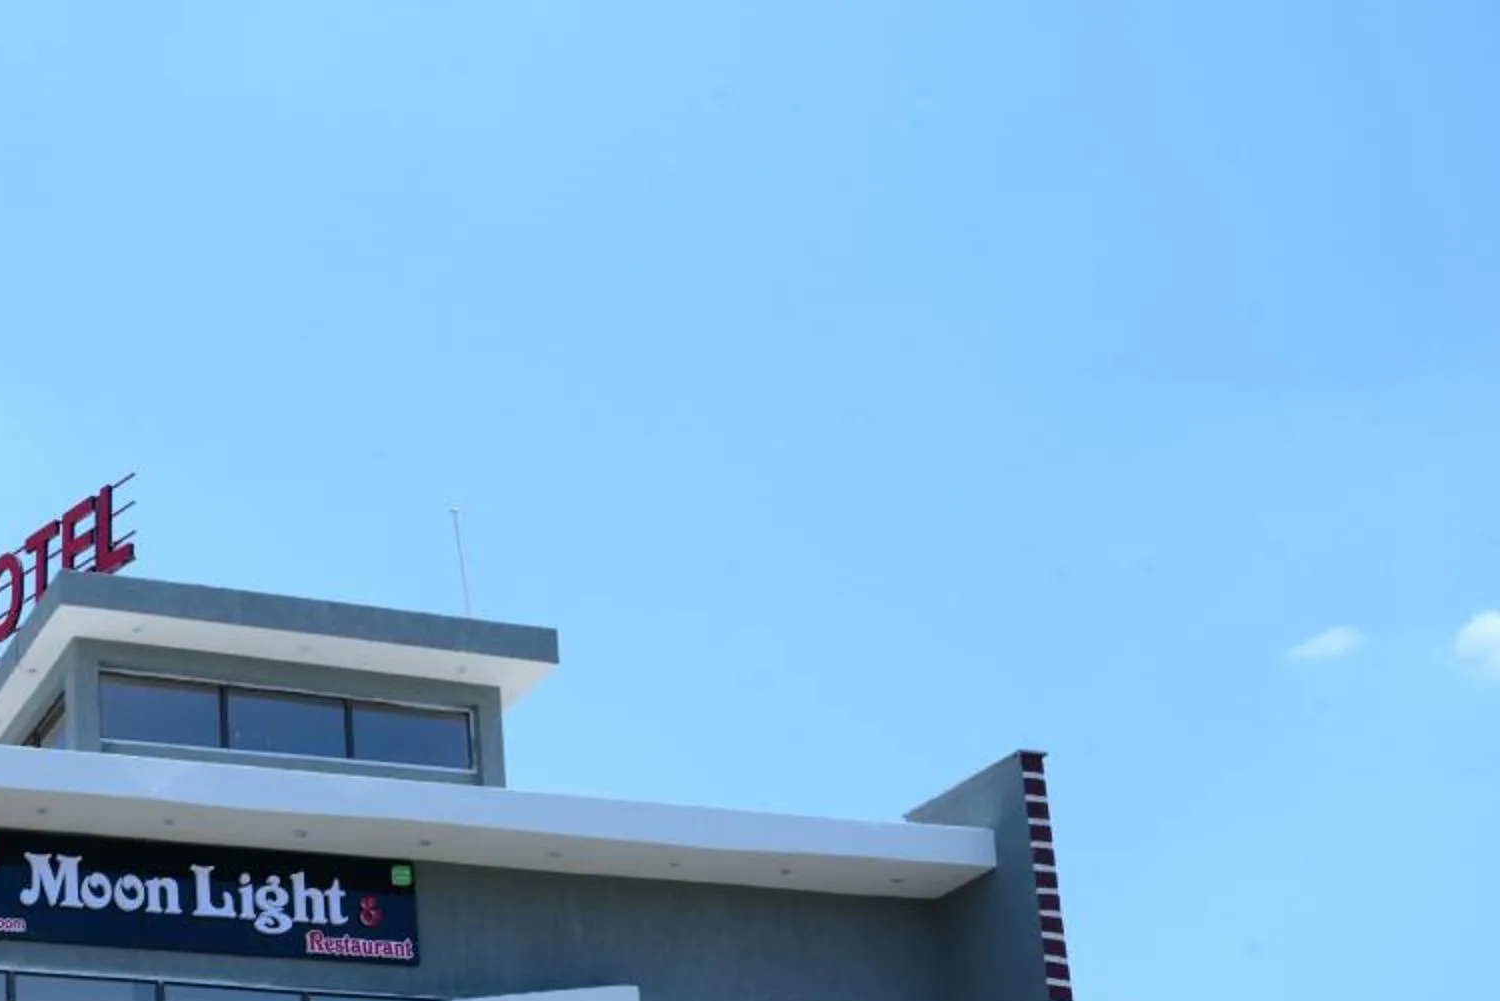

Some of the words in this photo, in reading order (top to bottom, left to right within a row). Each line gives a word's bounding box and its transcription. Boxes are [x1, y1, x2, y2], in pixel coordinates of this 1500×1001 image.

[19, 851, 184, 914] Moon
[190, 864, 348, 934] Light
[305, 929, 415, 960] Restaurant
